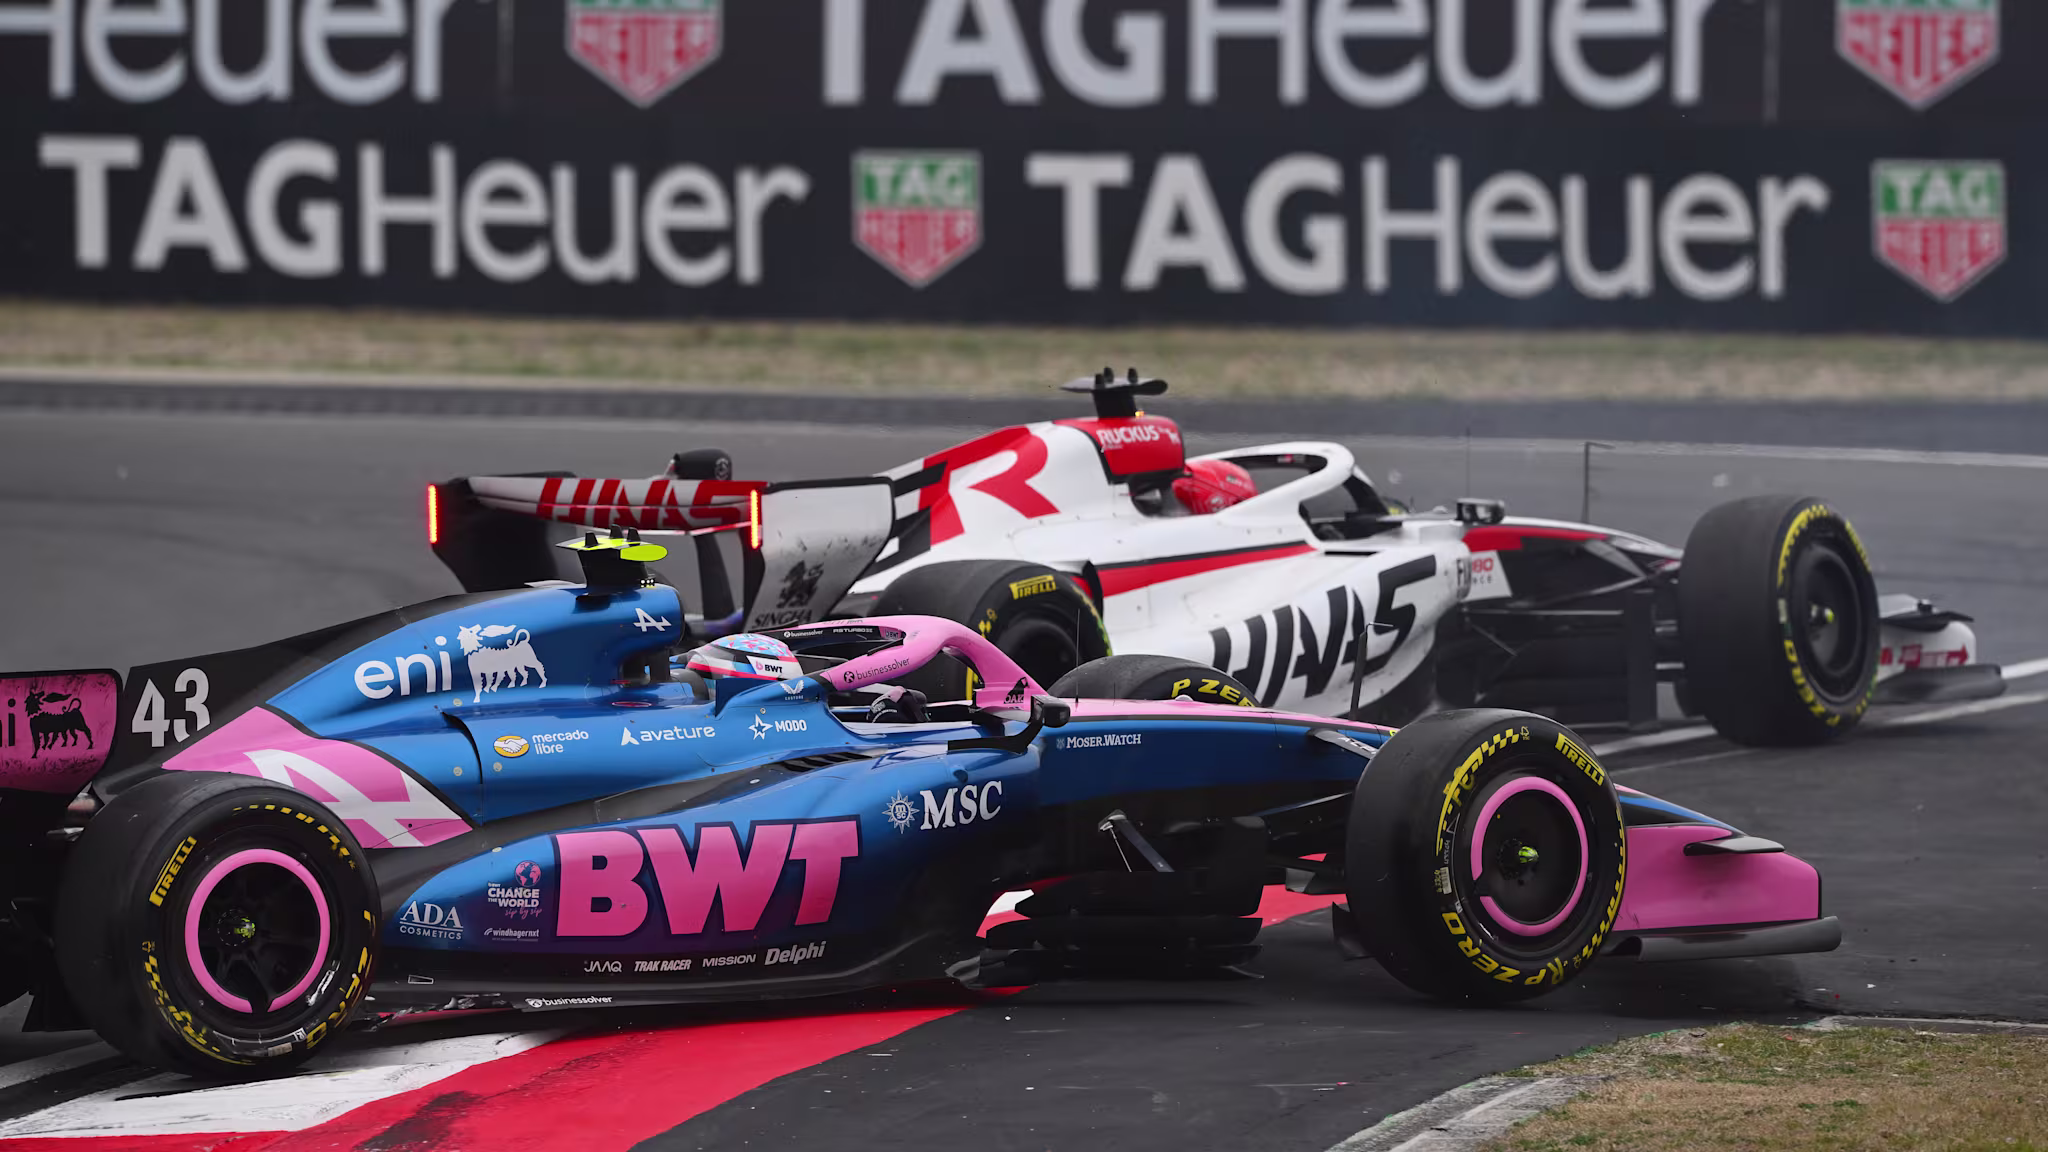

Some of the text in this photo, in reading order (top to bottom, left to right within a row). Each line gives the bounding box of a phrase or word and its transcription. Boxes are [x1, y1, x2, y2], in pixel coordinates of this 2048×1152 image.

[864, 158, 968, 206] TAG
[1884, 168, 1990, 218] TAG
[1096, 425, 1160, 444] RUCKUS
[1009, 574, 1056, 600] PIRELLI
[354, 636, 453, 699] eni
[764, 664, 783, 674] BWT
[856, 657, 911, 680] businessolver
[131, 668, 210, 748] 43
[640, 724, 716, 742] avature
[775, 719, 807, 733] MODO
[532, 729, 589, 745] mercado
[535, 742, 564, 755] libre
[1555, 732, 1604, 786] PIRELLI
[920, 781, 1002, 831] MSC
[149, 836, 197, 907] PIRELLI
[555, 820, 860, 938] BWT
[488, 887, 540, 898] CHANGE
[498, 898, 540, 907] WORLD
[401, 900, 463, 930] ADA
[505, 907, 542, 920] sip by sip
[400, 925, 463, 940] COSMETICS
[492, 928, 540, 939] windhagernxt
[764, 941, 827, 966] Delphi
[1441, 912, 1521, 983] ZERO
[634, 959, 692, 972] TRAK RACER
[702, 953, 756, 967] MISSION
[542, 995, 612, 1008] businessolver
